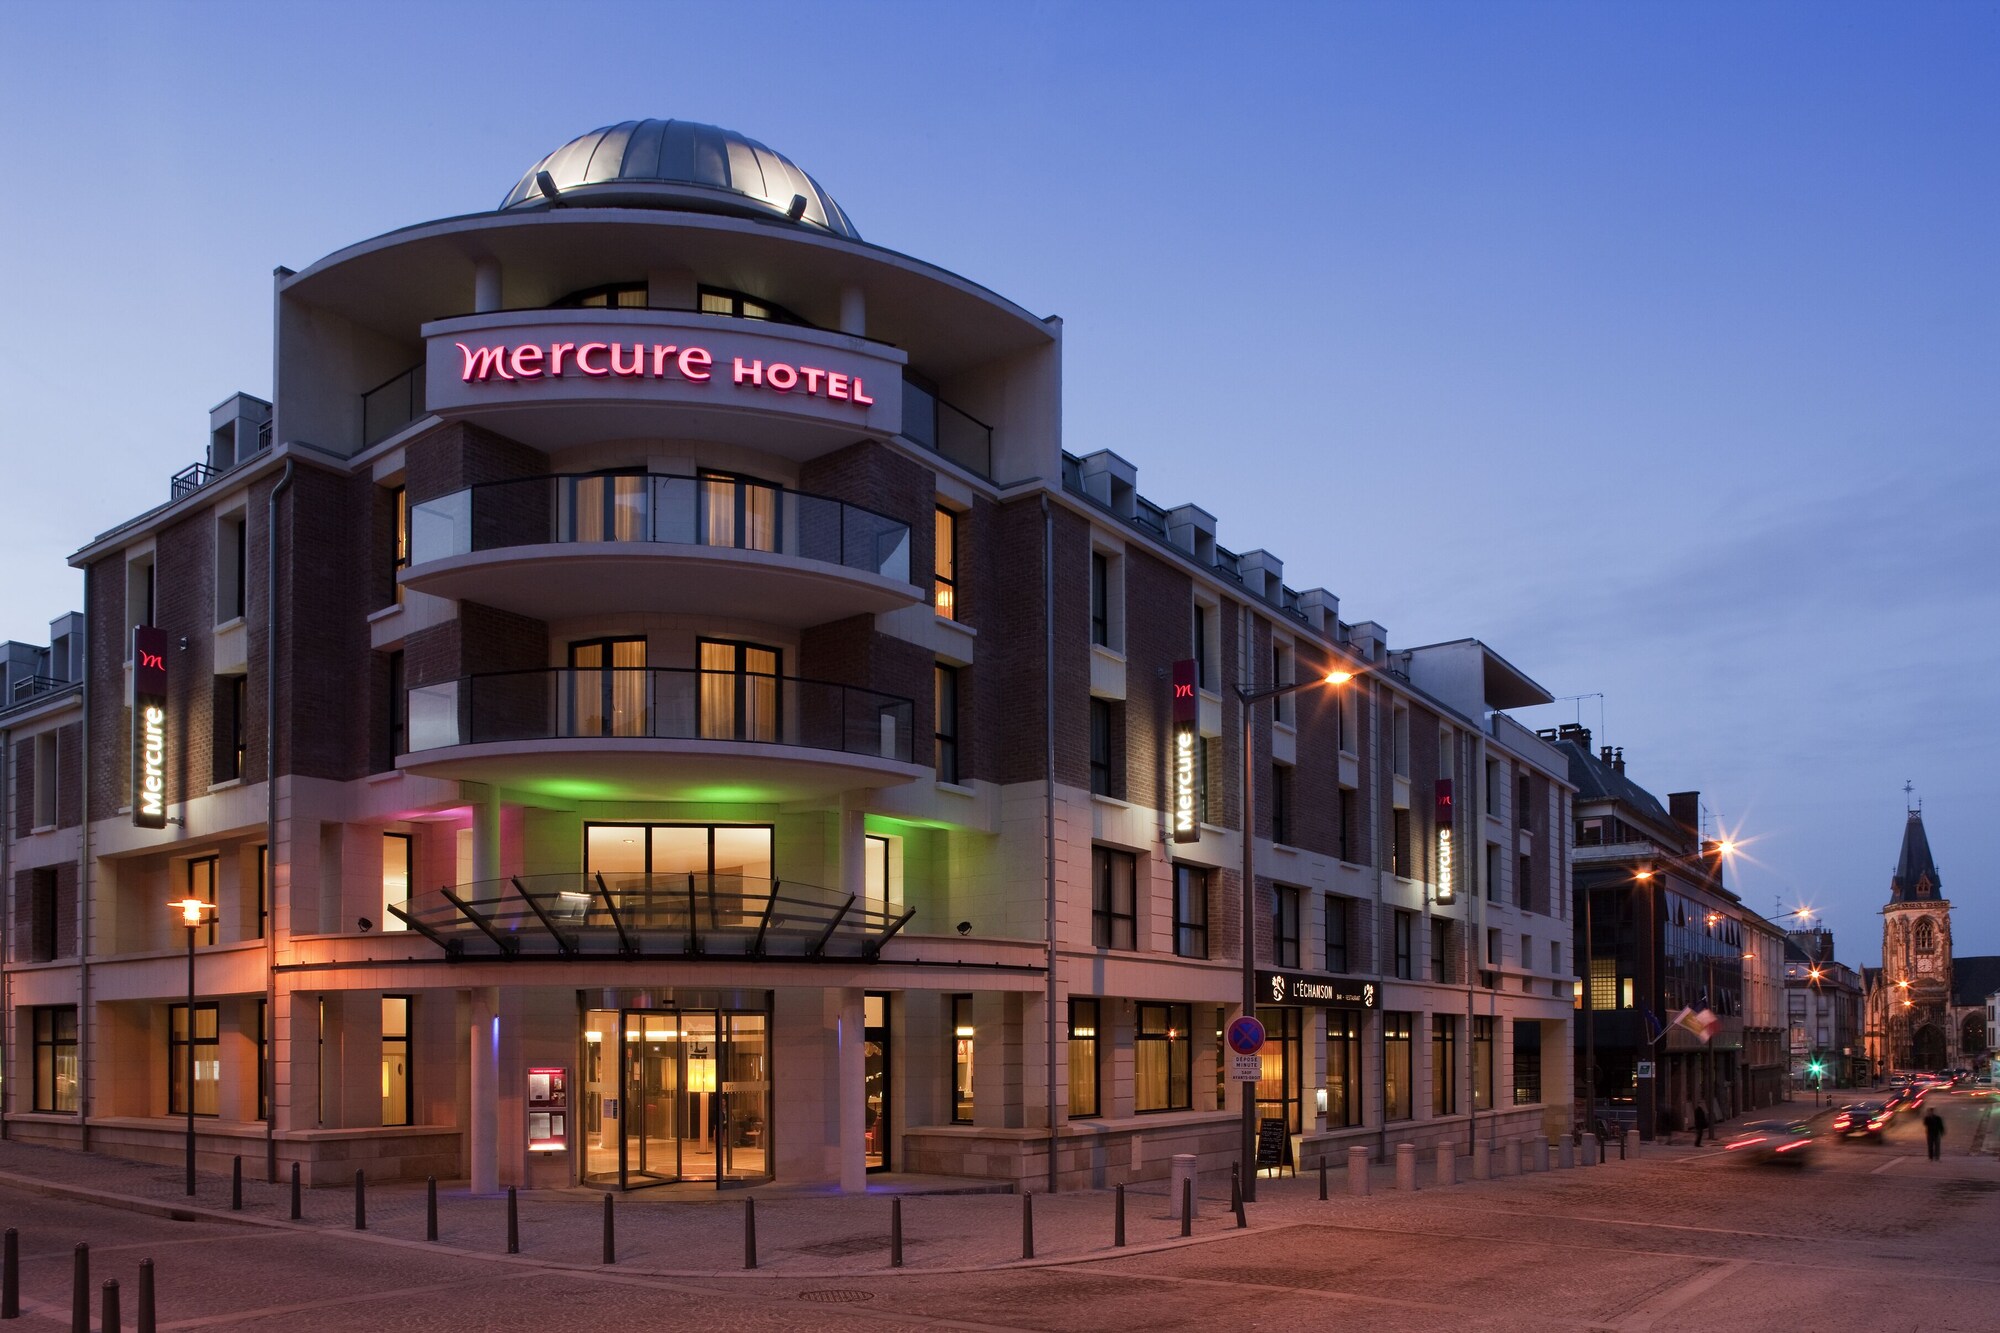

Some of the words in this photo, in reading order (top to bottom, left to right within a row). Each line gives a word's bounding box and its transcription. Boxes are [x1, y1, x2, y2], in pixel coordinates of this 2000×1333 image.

[734, 357, 873, 405] HOTEL
[142, 706, 163, 815] Mercure
[1177, 732, 1192, 831] Mercure
[1439, 828, 1451, 897] Mercure
